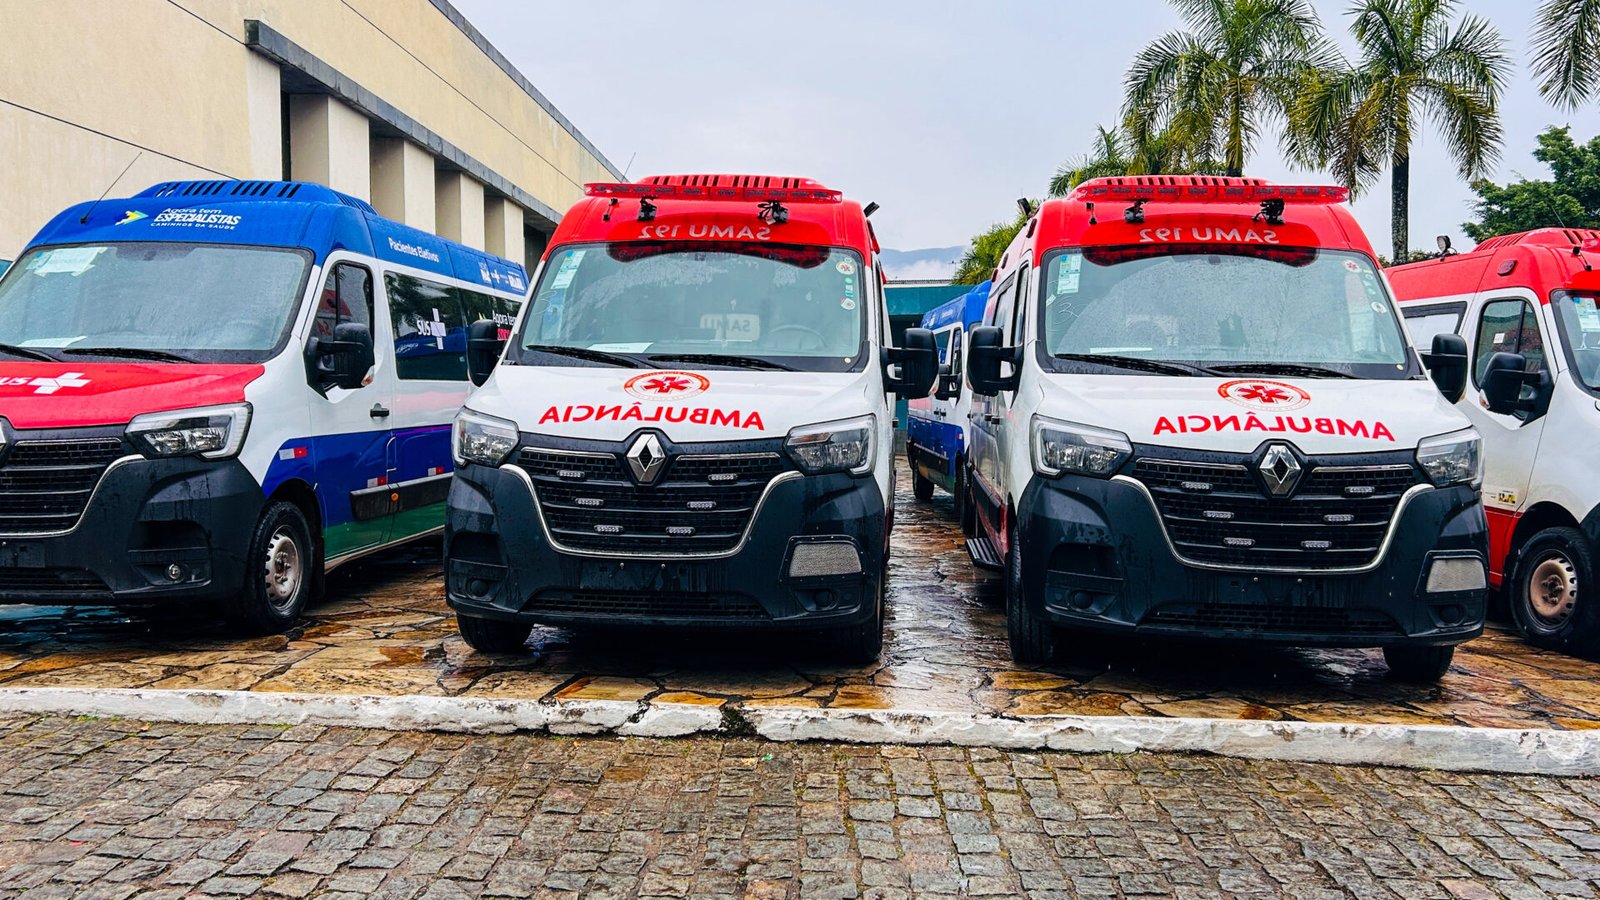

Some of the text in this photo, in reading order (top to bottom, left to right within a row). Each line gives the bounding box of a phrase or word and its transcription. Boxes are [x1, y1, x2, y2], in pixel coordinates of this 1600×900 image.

[154, 213, 241, 225] ESPECIALISTAS
[388, 237, 439, 262] Pacientes Eletivos
[492, 310, 508, 327] Agora
[417, 320, 431, 336] SUS
